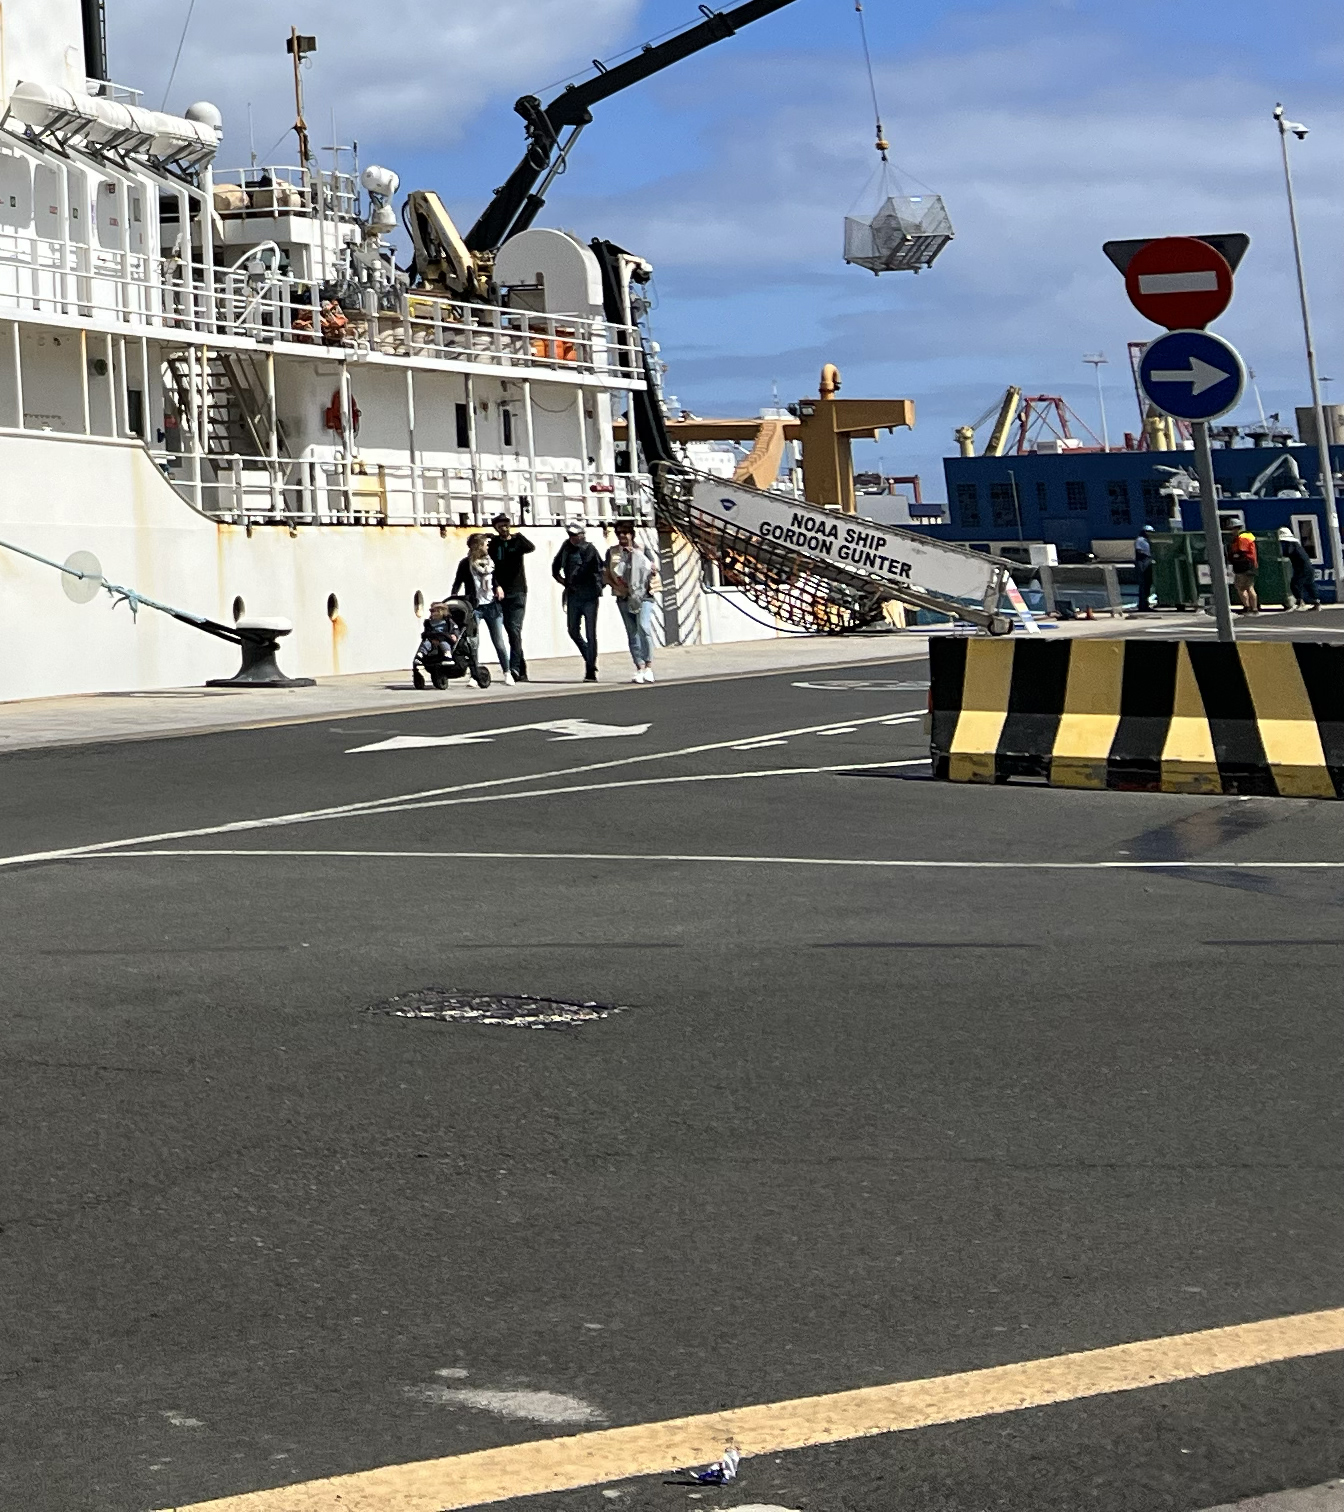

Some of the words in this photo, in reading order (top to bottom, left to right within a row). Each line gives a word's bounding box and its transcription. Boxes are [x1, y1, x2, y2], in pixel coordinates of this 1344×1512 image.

[759, 521, 834, 556] GORDON
[837, 544, 912, 579] GUNTER
[790, 512, 839, 540] NOAA
[844, 528, 887, 552] SHIP
